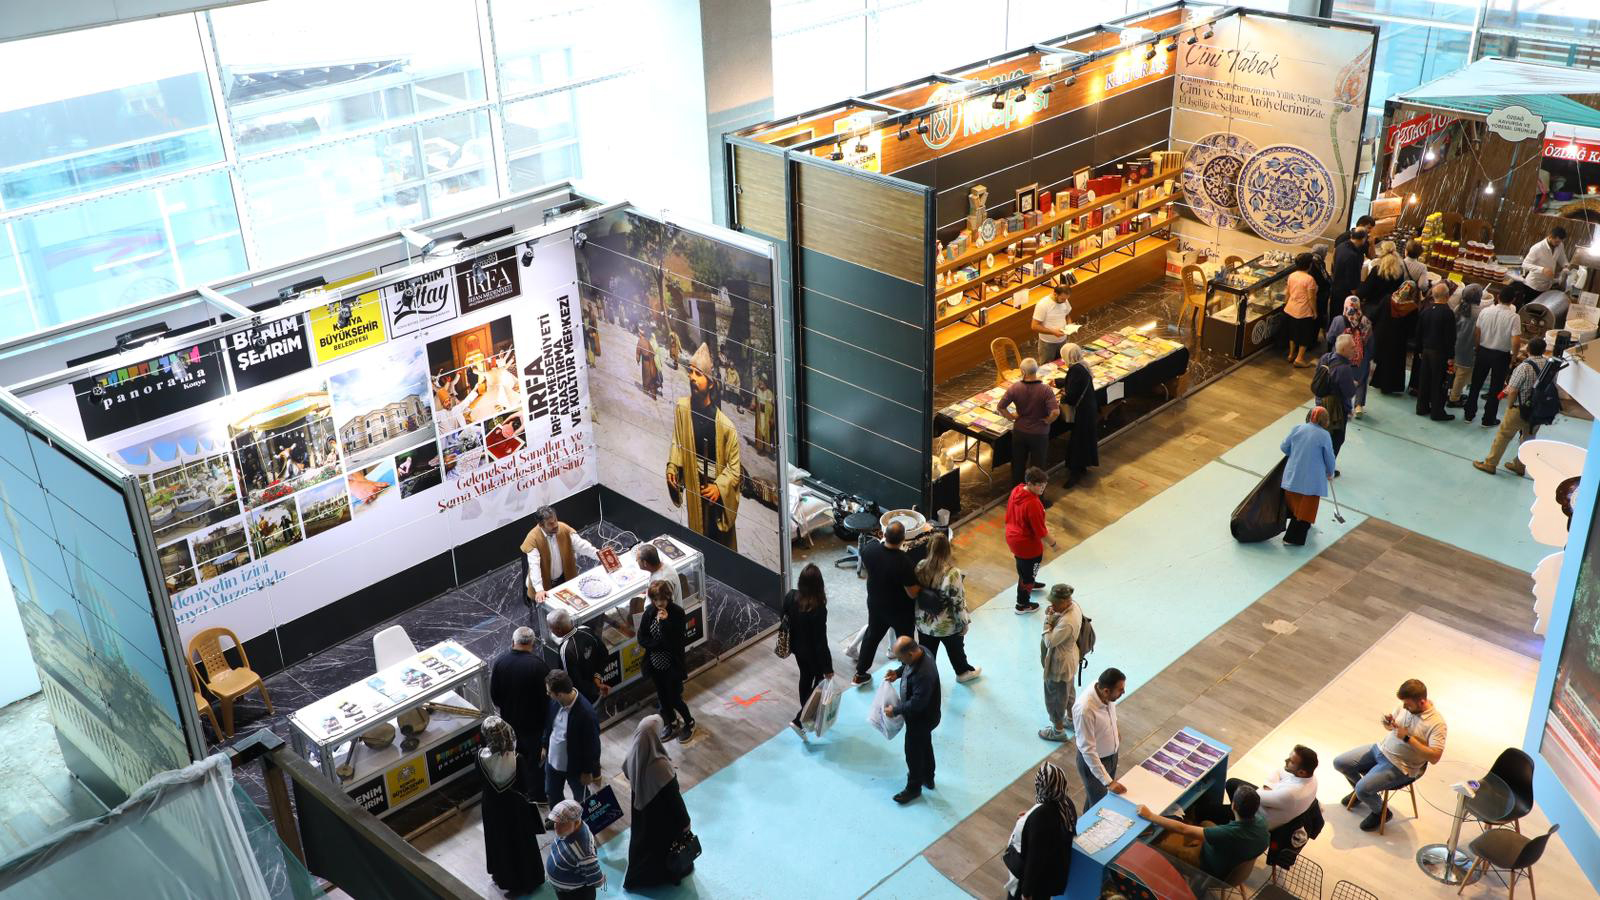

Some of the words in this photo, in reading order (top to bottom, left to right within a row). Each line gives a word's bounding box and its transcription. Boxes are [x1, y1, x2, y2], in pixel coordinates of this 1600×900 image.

[1185, 44, 1223, 68] Çini
[1227, 49, 1279, 79] Tabak
[1180, 81, 1201, 95] Çini
[1203, 89, 1214, 98] ve
[1217, 88, 1244, 104] Sanat
[557, 294, 573, 356] MERKEZİ
[237, 335, 302, 371] ŞEHRİM
[537, 313, 557, 395] MEDENİYETİ
[103, 369, 206, 411] panorama
[183, 378, 206, 390] Konya
[524, 355, 549, 421] İRFA
[550, 396, 562, 437] İRFAN
[571, 408, 582, 428] VE
